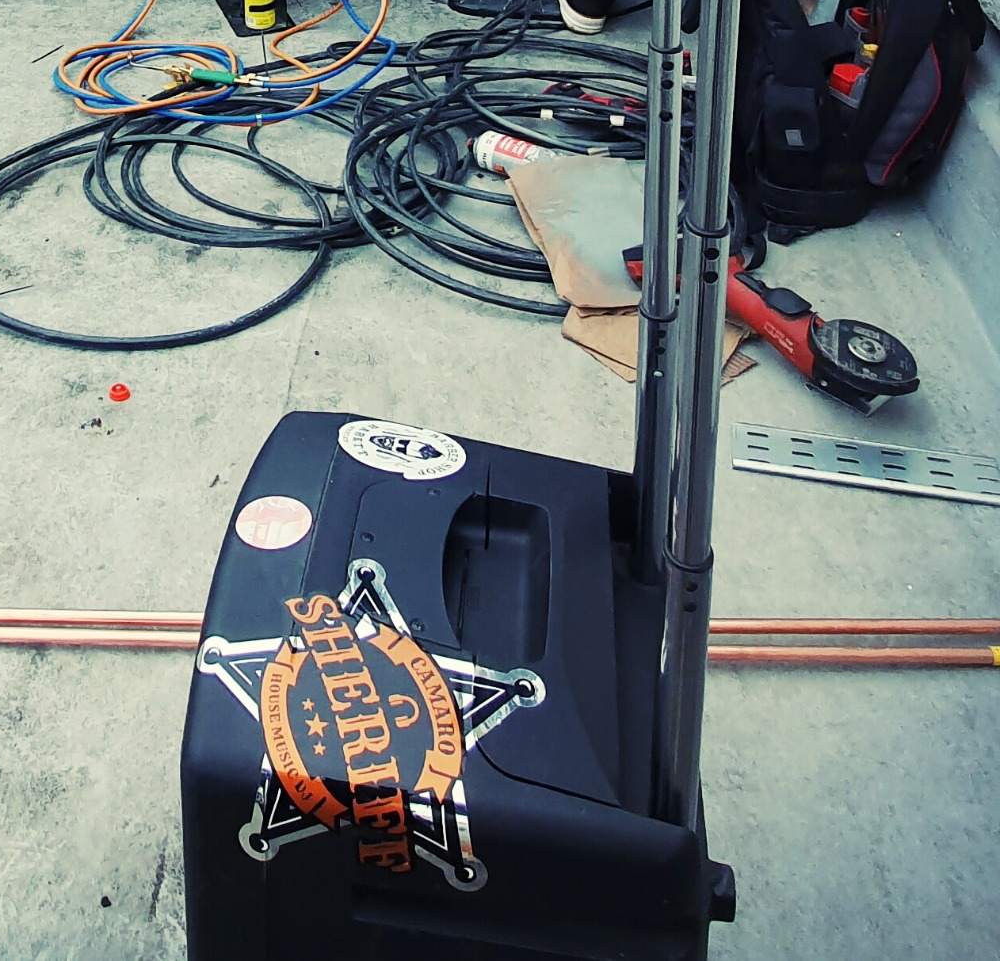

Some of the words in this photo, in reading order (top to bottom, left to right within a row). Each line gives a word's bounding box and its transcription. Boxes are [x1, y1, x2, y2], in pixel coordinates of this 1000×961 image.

[267, 672, 284, 724] HOUSE
[410, 656, 457, 756] CAMARO
[271, 726, 300, 779] MUSIC
[285, 595, 412, 873] SHERIFF
[293, 782, 314, 802] DJ
